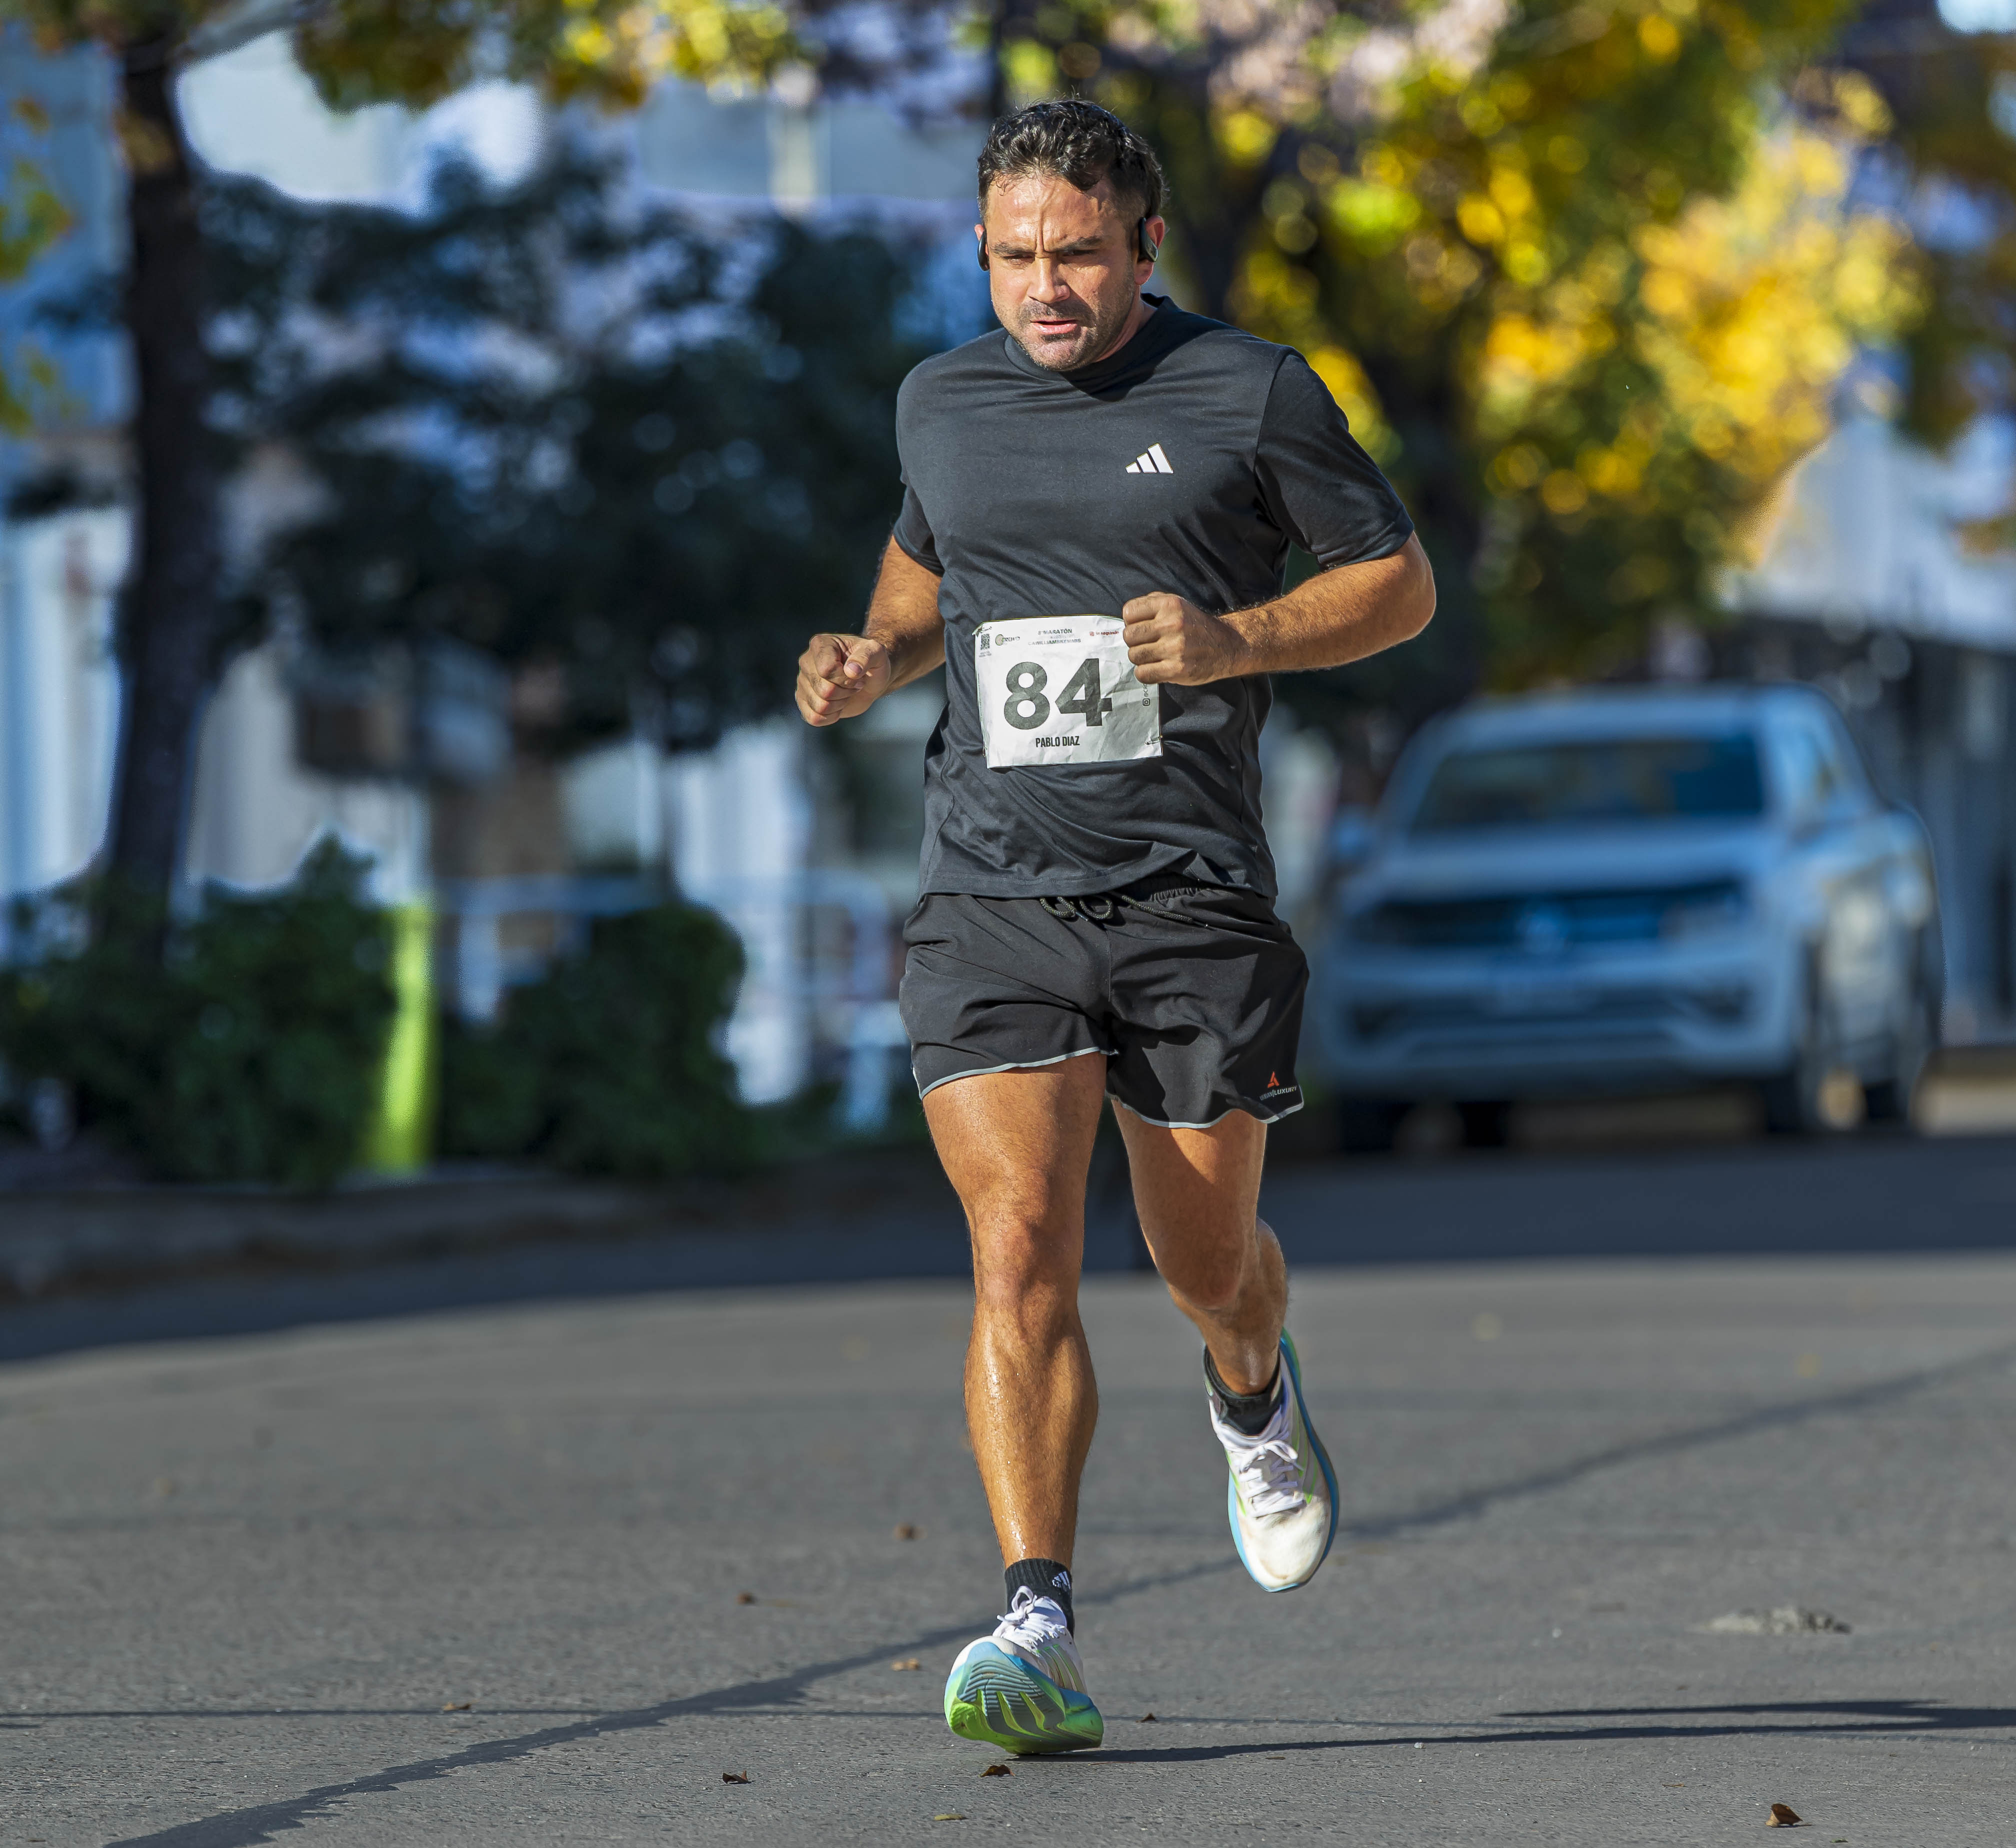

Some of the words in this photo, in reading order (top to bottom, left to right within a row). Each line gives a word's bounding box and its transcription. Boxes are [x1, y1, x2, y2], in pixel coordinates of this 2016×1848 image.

[1004, 658, 1112, 730] 84
[1036, 737, 1060, 748] PABLO
[1062, 736, 1080, 746] DIAZ
